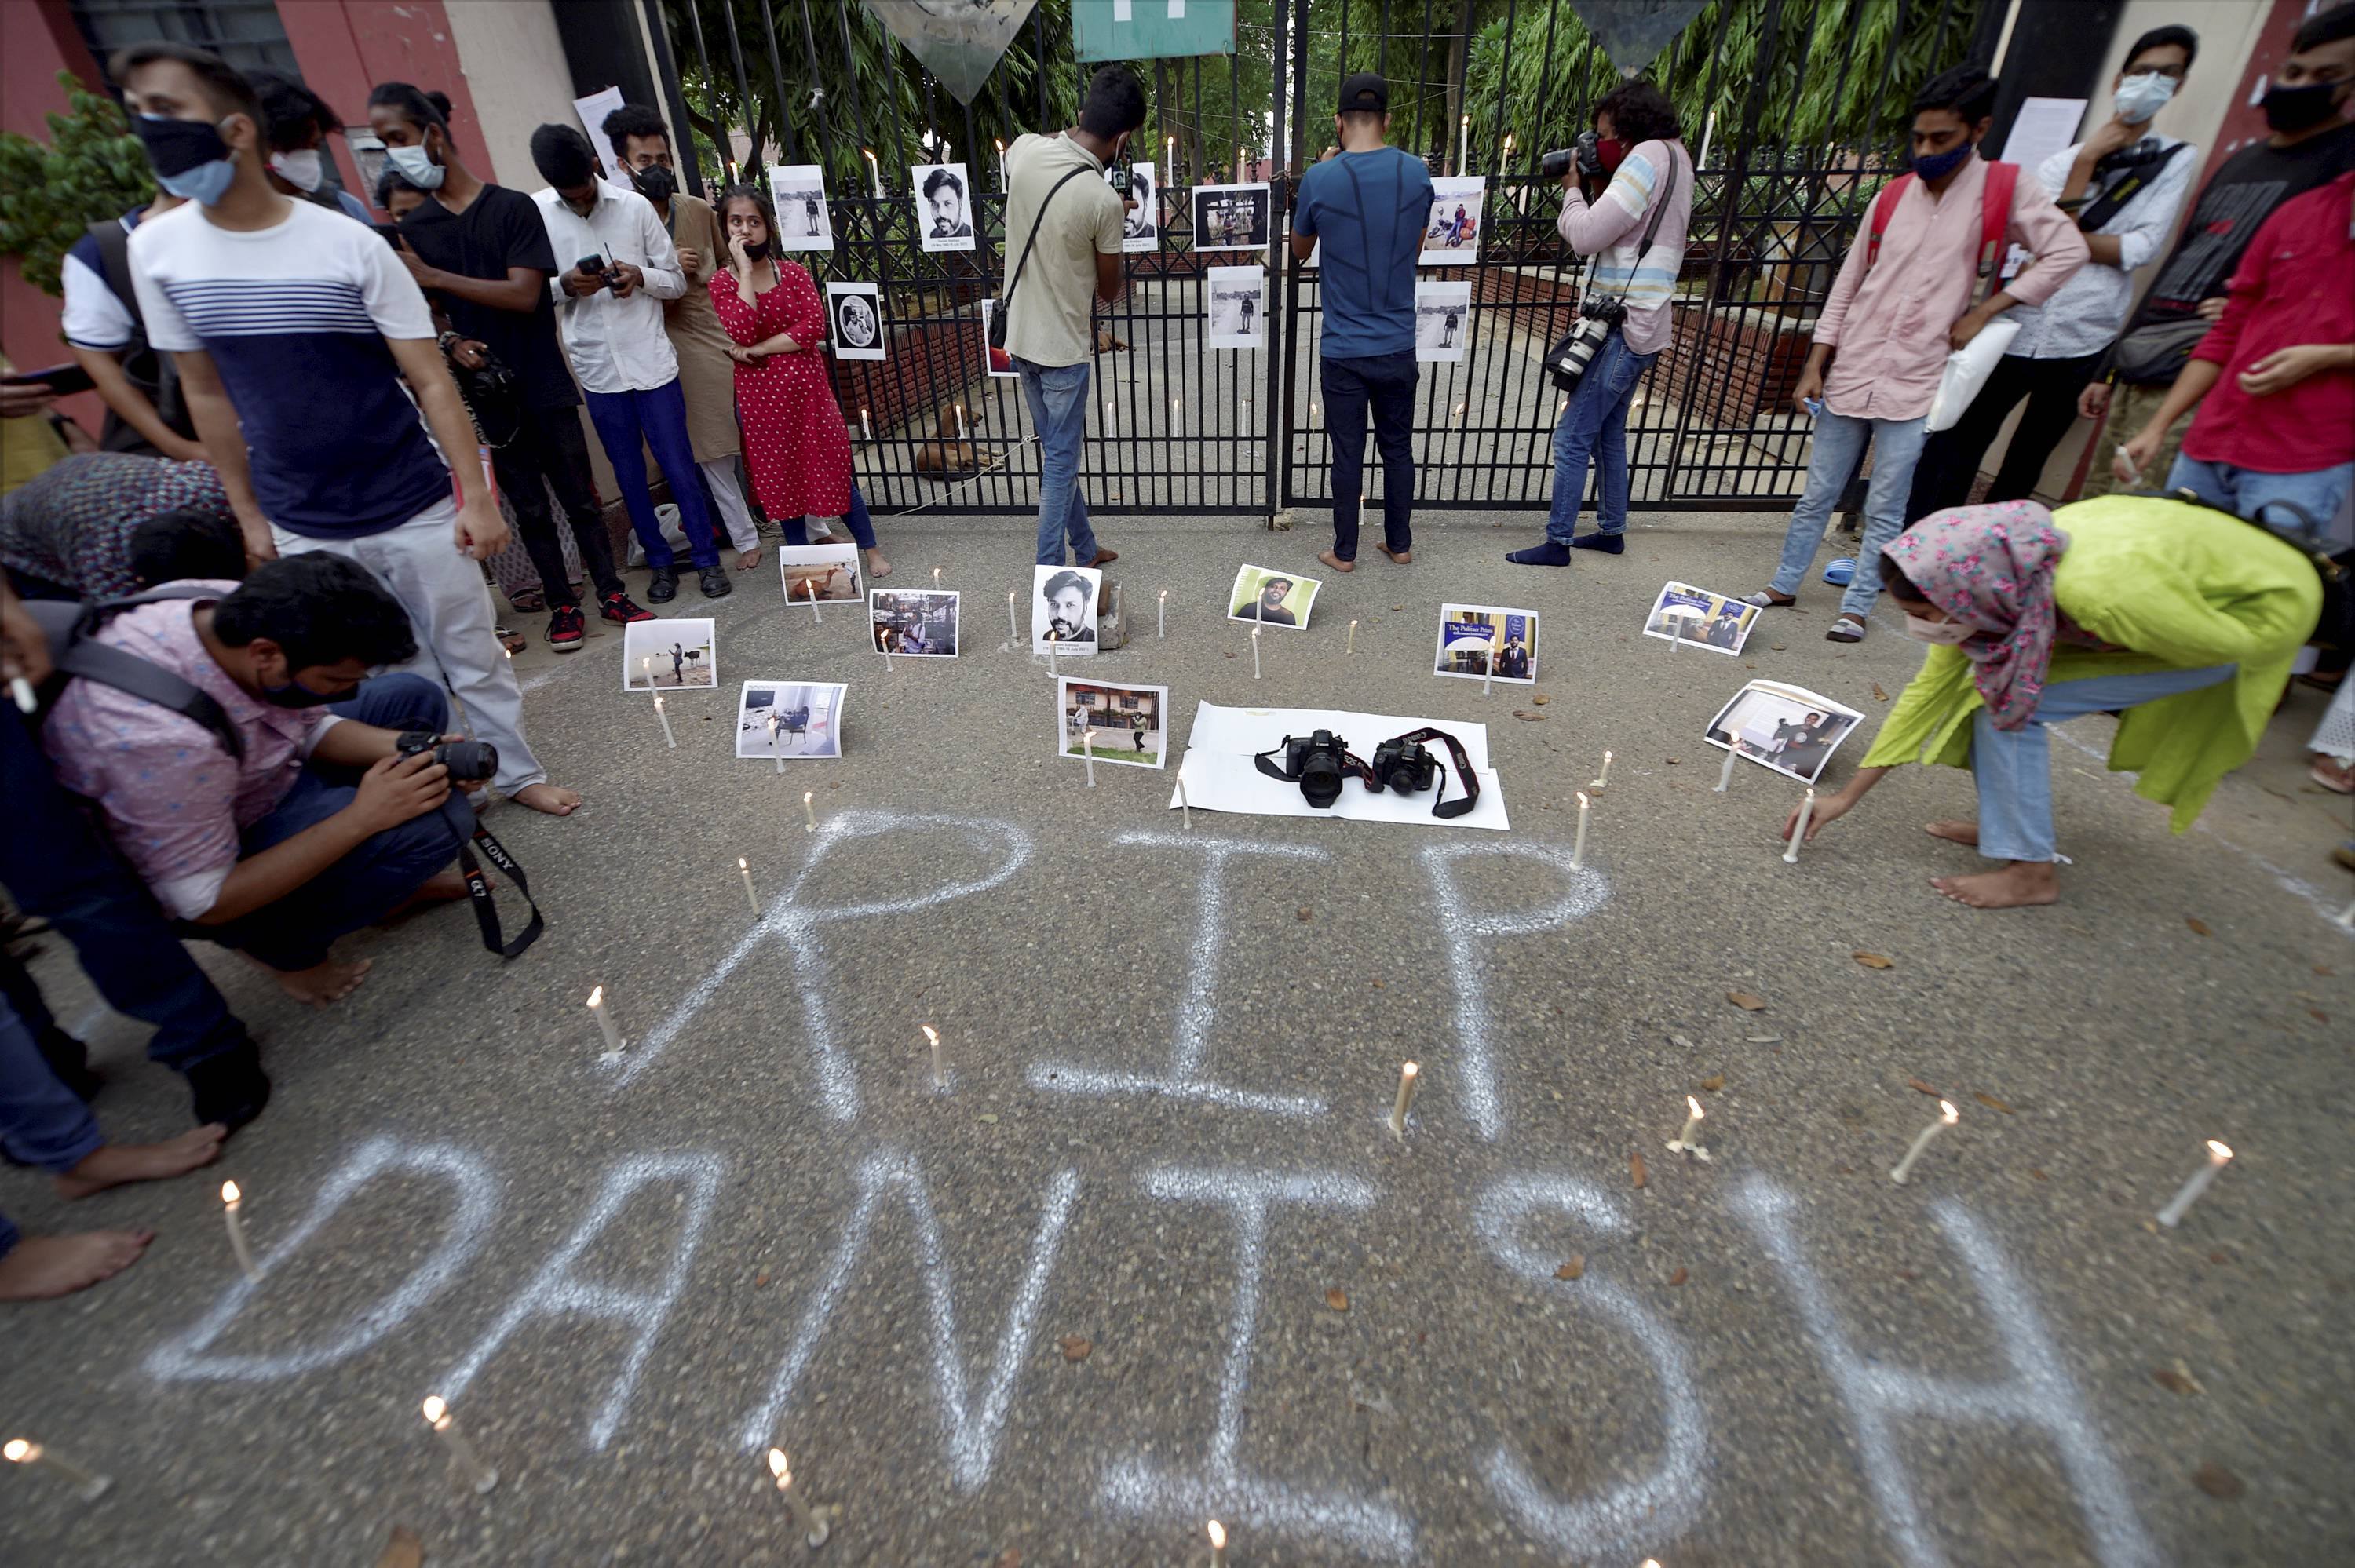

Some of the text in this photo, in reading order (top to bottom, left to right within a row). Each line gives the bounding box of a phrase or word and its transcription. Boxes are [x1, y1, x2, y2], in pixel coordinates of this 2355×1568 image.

[480, 837, 514, 870] SONY
[604, 810, 1614, 1143] RIP
[144, 1134, 2162, 1568] DANISH
